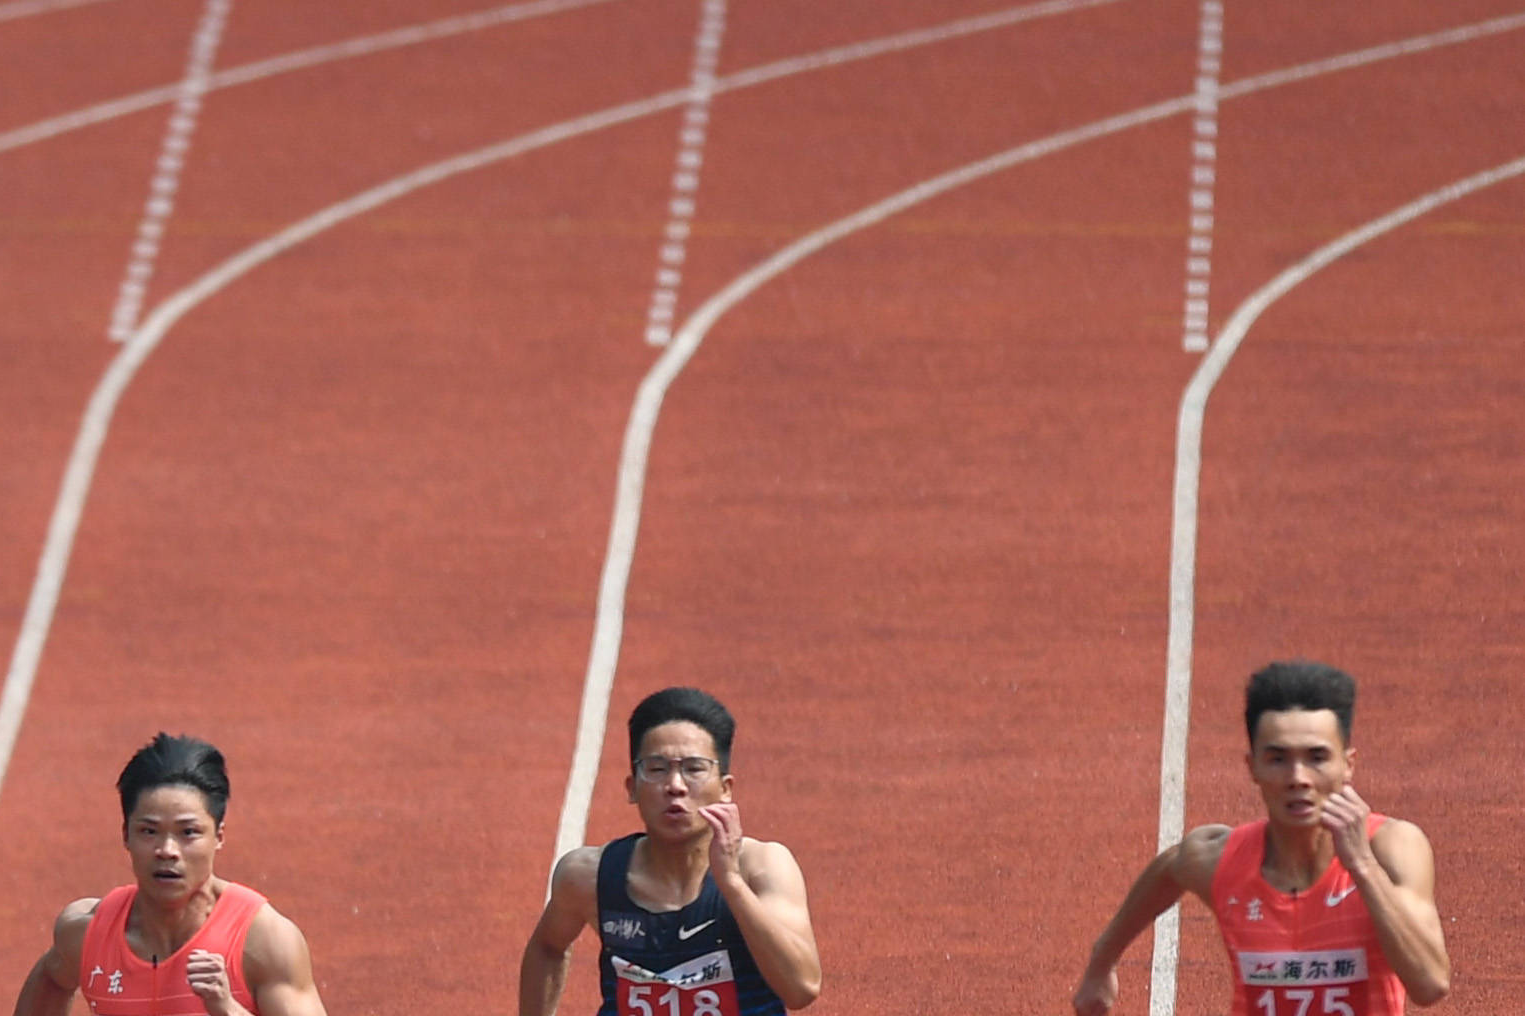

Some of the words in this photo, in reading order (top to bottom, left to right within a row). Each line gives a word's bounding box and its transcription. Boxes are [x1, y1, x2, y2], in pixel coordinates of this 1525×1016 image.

[88, 965, 124, 995] 广东
[1283, 959, 1357, 980] 海尔斯
